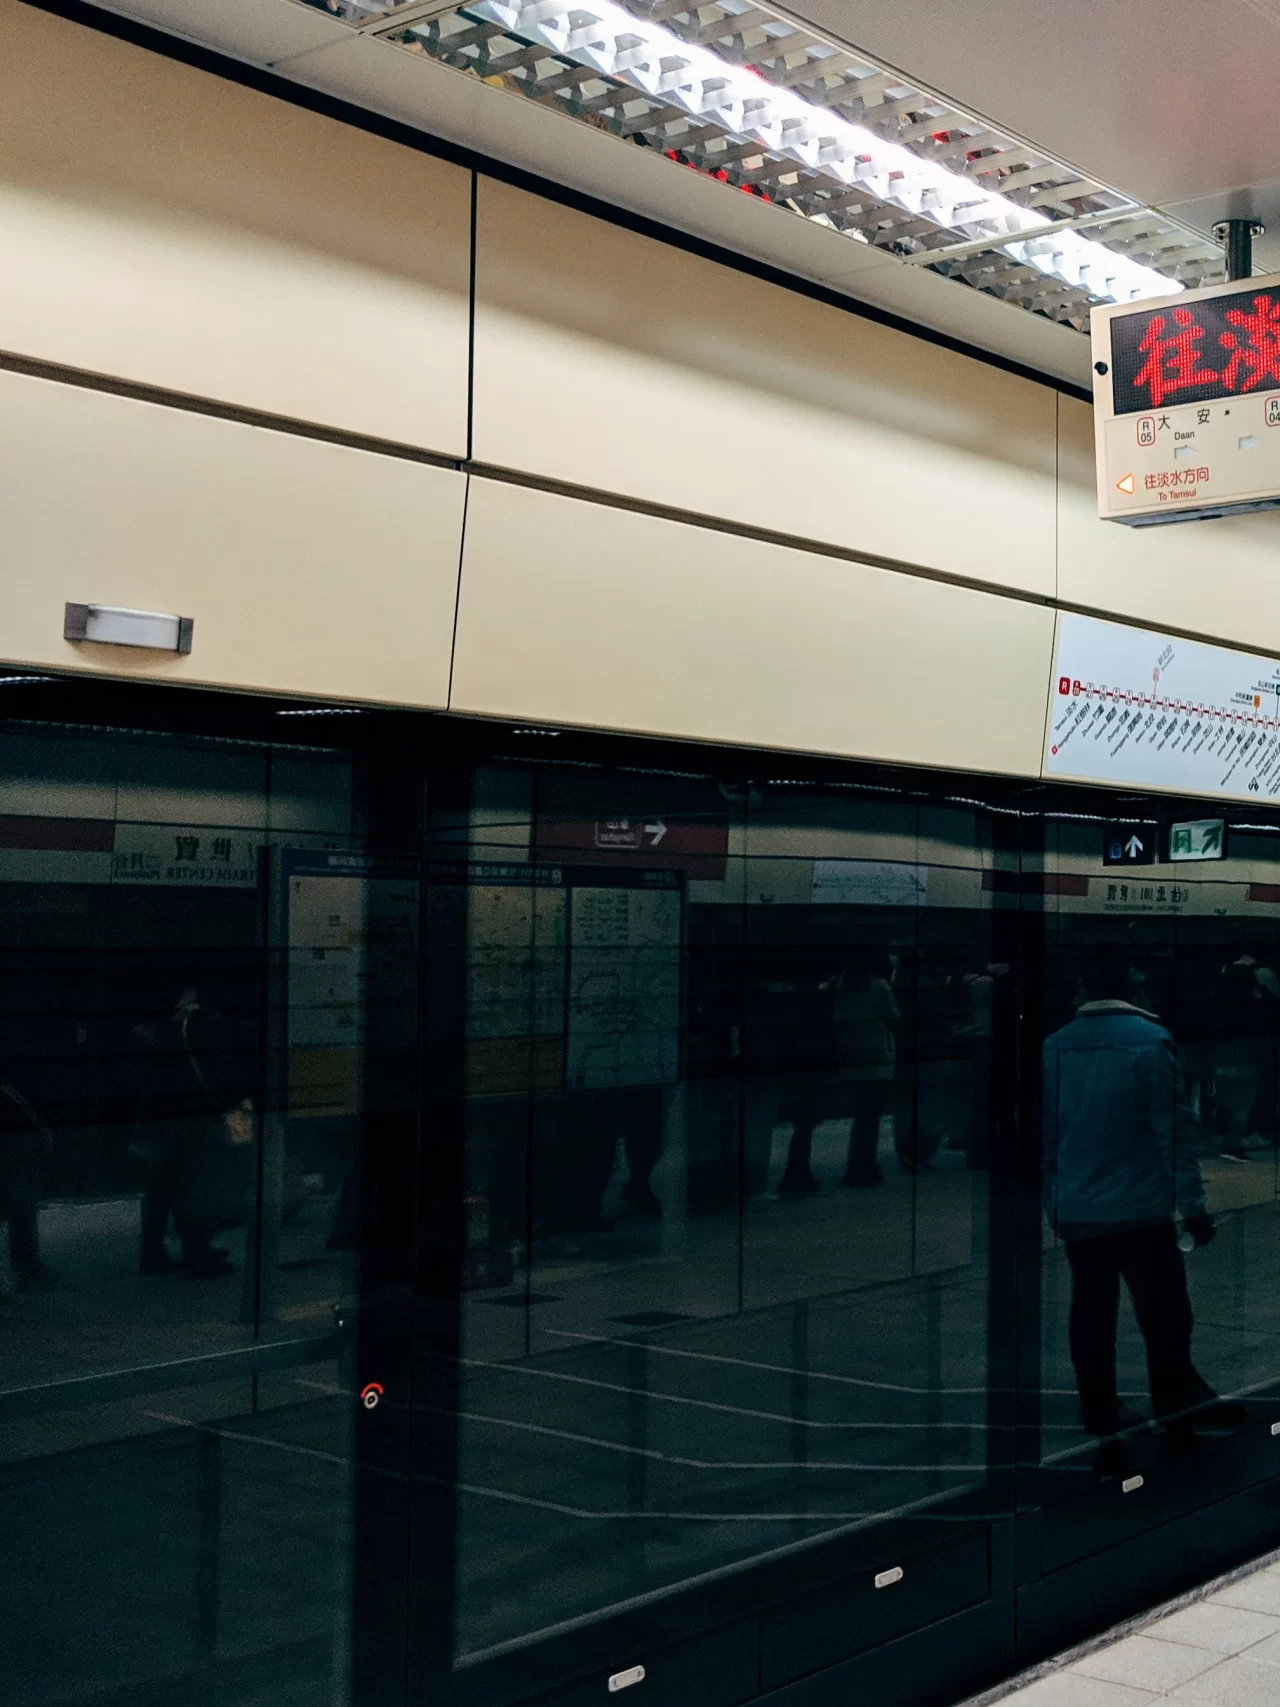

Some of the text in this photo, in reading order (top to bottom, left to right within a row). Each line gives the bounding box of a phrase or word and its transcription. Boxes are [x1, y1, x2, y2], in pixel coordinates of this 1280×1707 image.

[1271, 400, 1279, 411] R
[1269, 411, 1280, 423] 04
[1142, 421, 1150, 431] R
[1140, 432, 1152, 443] 05
[1174, 430, 1195, 442] Daan
[1144, 466, 1210, 490] 往淡水方向
[1158, 489, 1197, 501] To Tamsui
[1061, 681, 1068, 691] R
